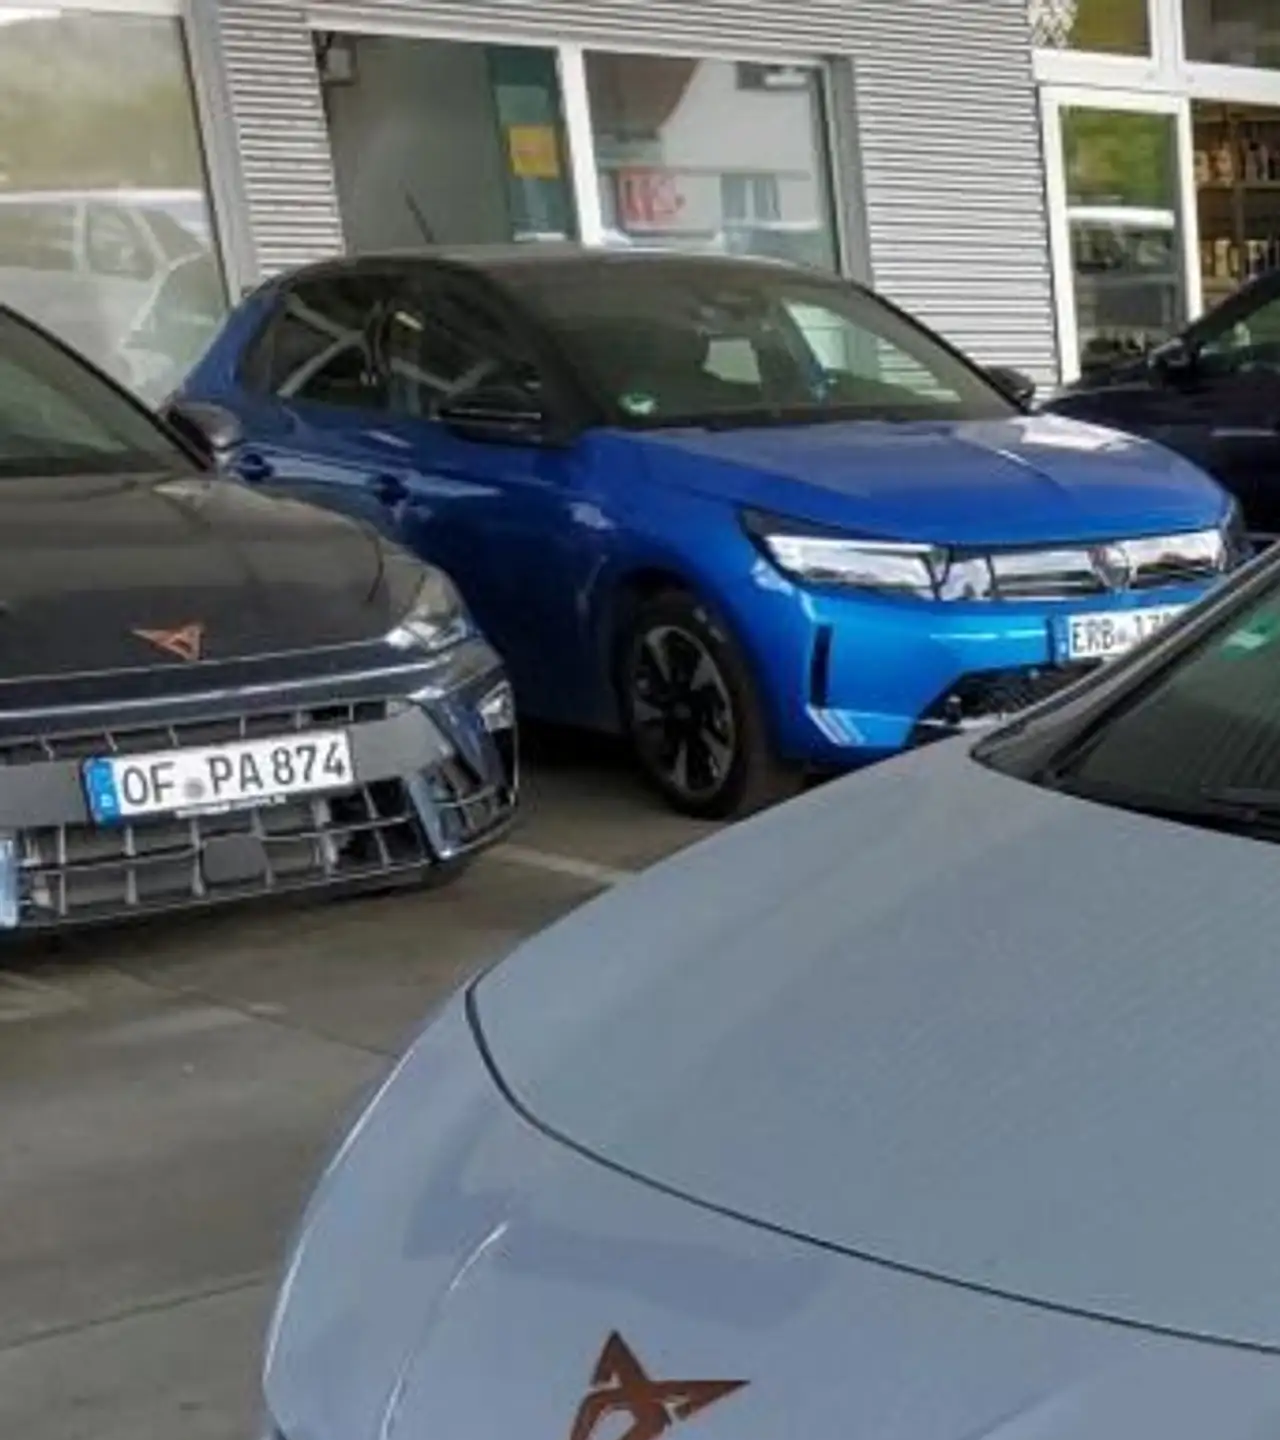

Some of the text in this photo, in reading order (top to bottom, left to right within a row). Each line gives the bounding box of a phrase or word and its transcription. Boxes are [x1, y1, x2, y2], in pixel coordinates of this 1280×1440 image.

[1072, 618, 1115, 653] ERB
[122, 761, 175, 807] OF
[206, 752, 264, 795] PA
[270, 741, 346, 786] 874
